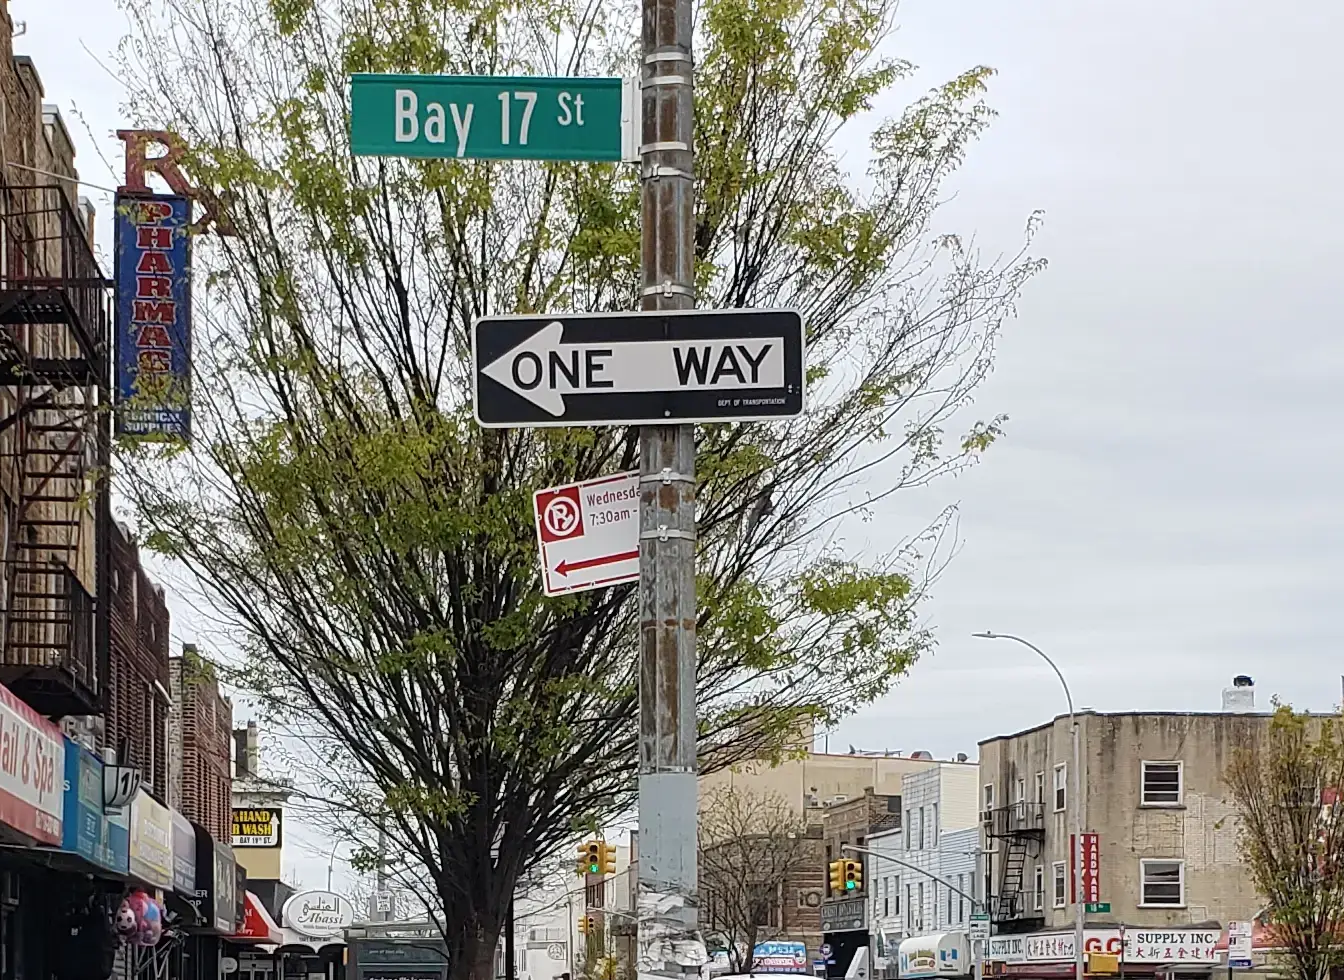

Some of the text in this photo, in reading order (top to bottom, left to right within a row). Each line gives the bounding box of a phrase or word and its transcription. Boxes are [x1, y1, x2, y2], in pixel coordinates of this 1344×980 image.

[395, 89, 585, 157] Bay 17 St
[132, 201, 176, 393] PHARMAC
[511, 344, 773, 391] ONE WAY
[587, 485, 640, 507] Wednesda
[589, 509, 630, 527] 7:30am
[34, 737, 54, 804] Spa
[239, 810, 270, 822] HAND
[242, 824, 272, 835] WASH
[1089, 835, 1098, 902] HARDWARE
[297, 912, 344, 925] Abassi
[1137, 934, 1186, 943] SUPPLY
[1190, 934, 1217, 944] INC.
